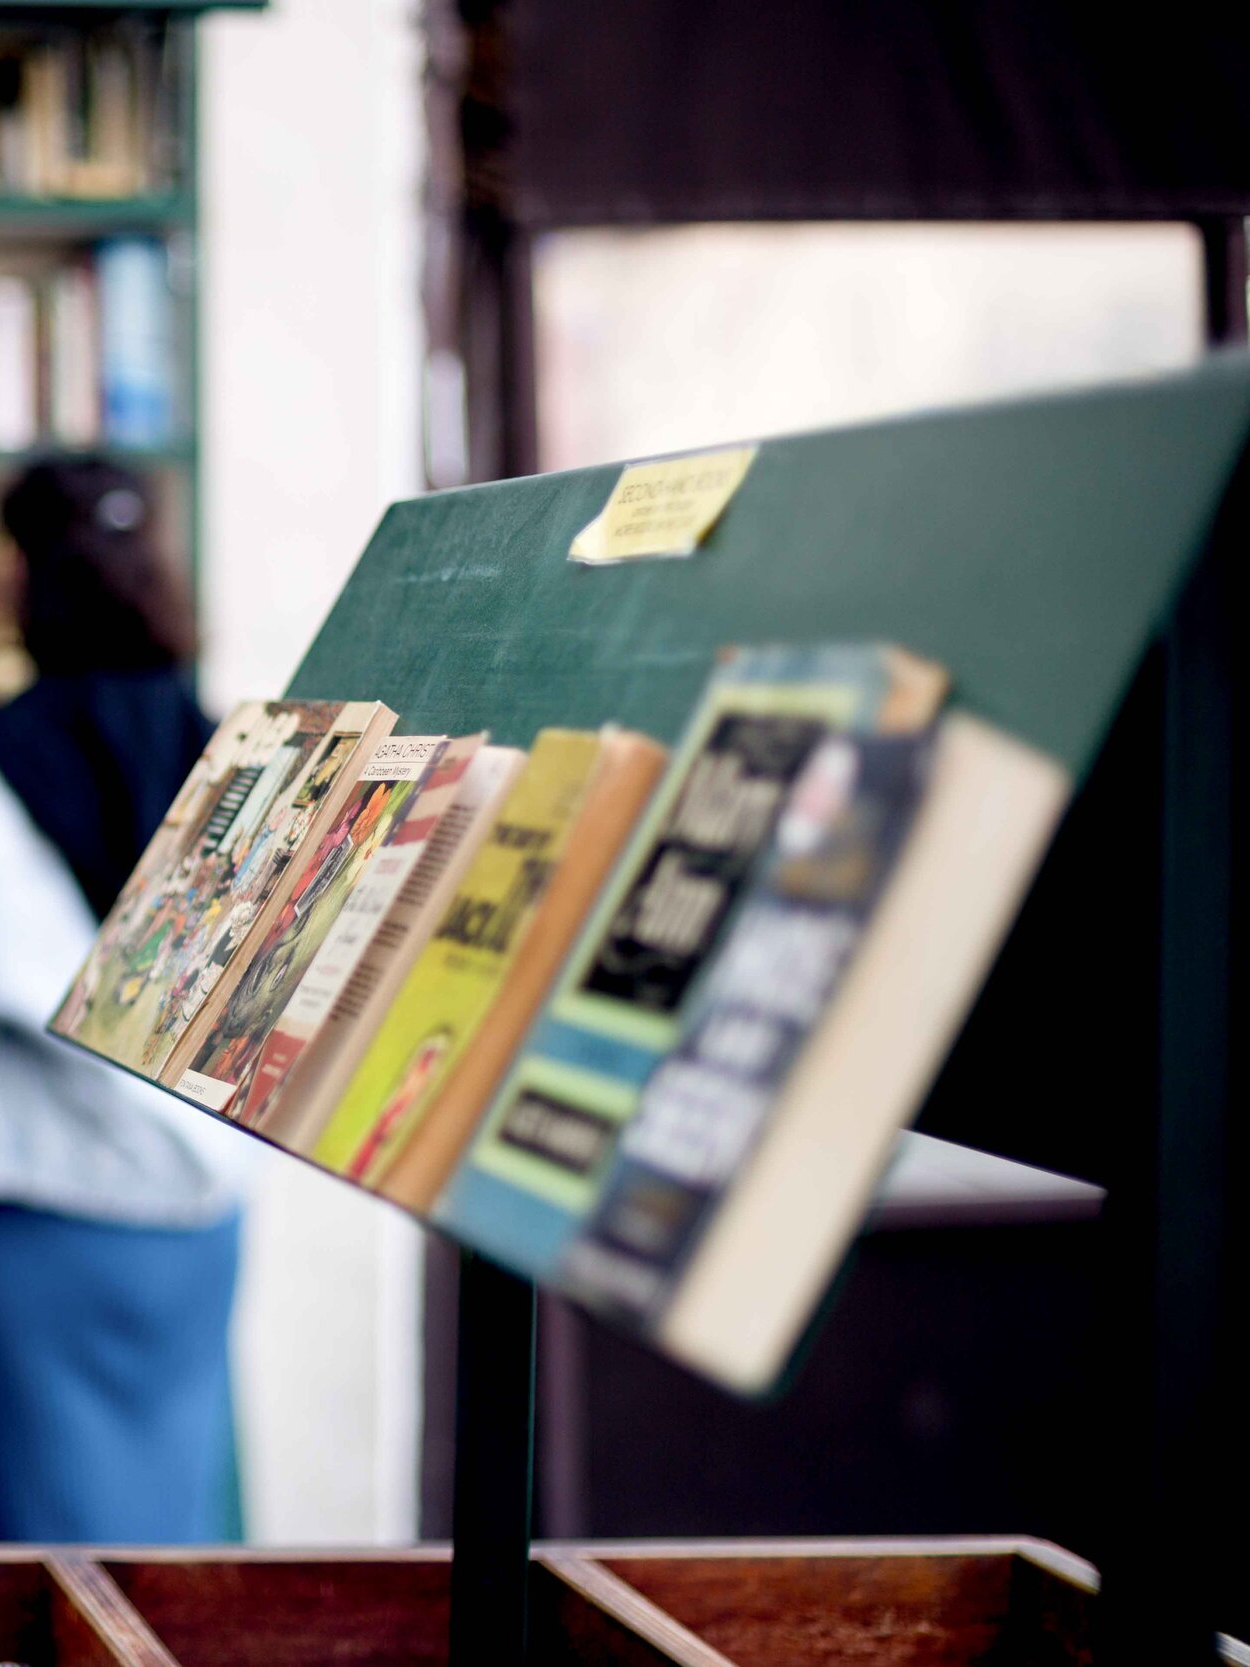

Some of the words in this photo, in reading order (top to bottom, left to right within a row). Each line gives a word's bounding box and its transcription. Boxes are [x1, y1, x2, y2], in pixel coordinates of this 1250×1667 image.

[374, 744, 405, 759] AGATHA
[368, 766, 393, 776] Caribbean
[392, 766, 412, 778] Mystery
